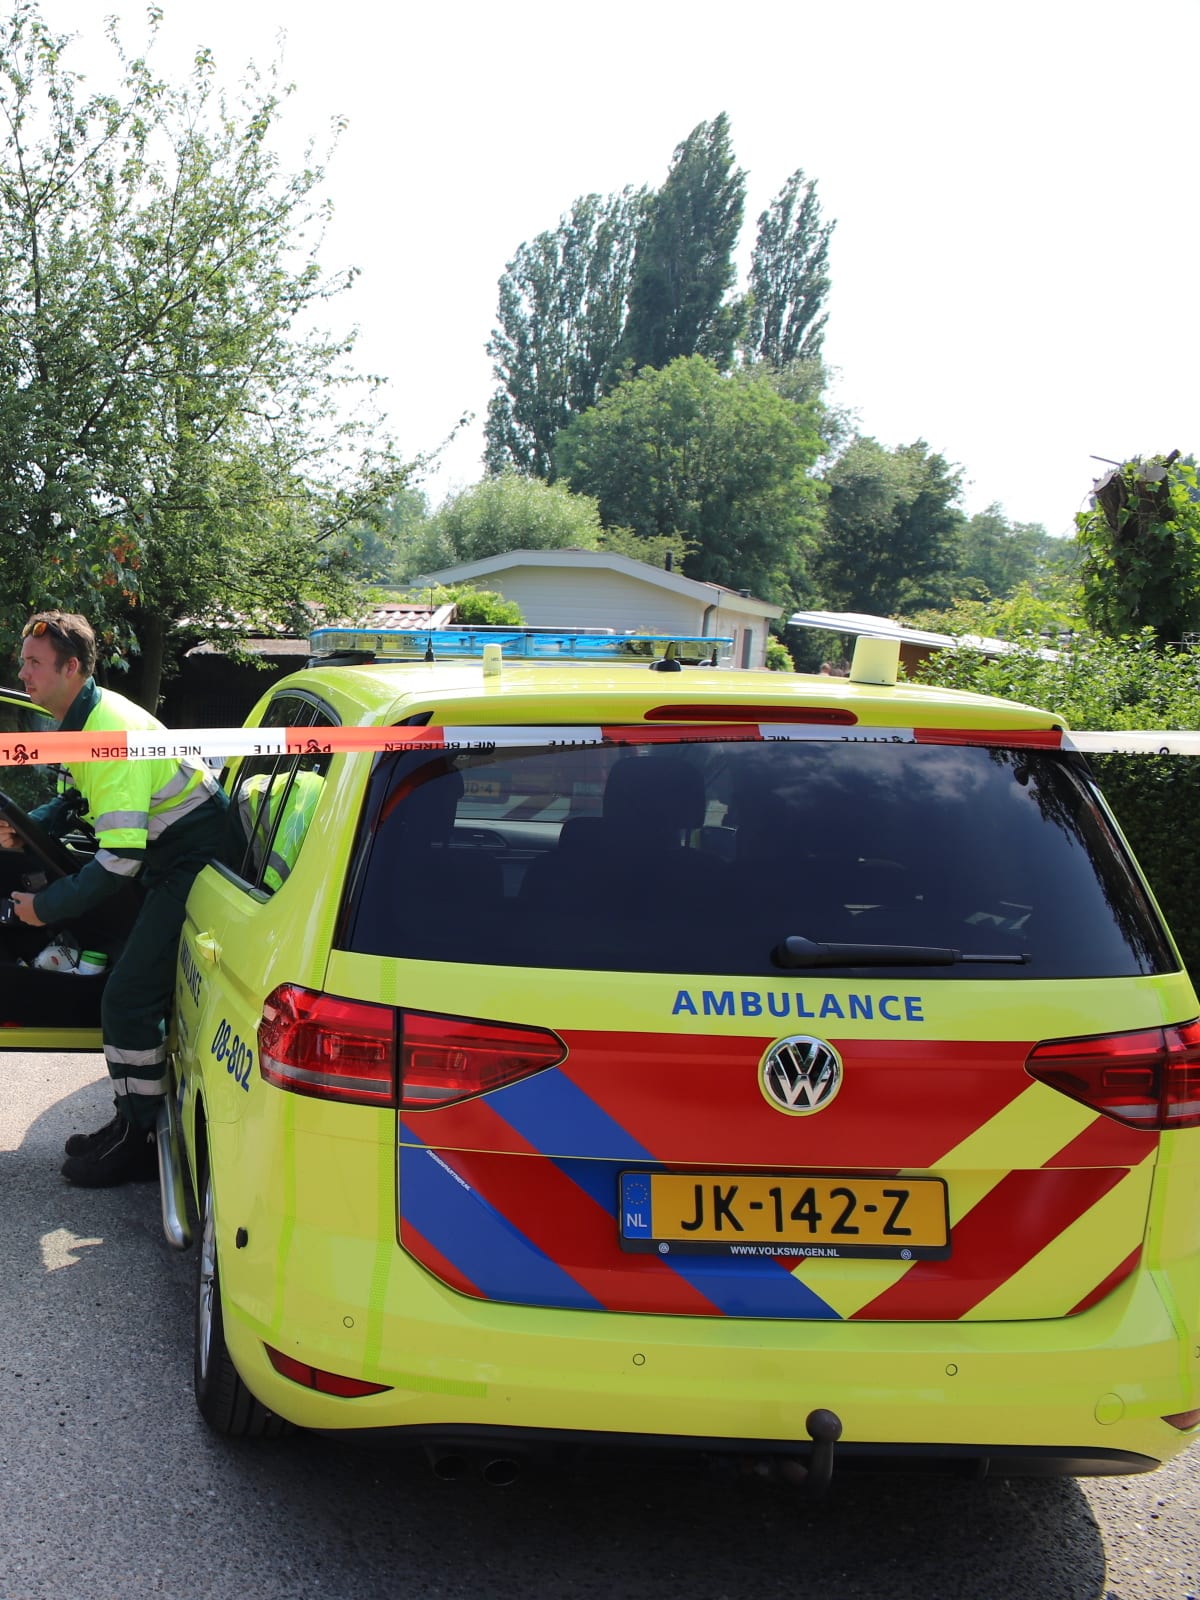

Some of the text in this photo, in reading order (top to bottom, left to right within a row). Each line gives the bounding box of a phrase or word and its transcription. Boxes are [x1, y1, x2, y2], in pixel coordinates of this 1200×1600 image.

[91, 746, 201, 757] NIET BETREDEN
[671, 989, 925, 1022] AMBULANCE
[211, 1018, 254, 1092] 08-802
[626, 1213, 648, 1228] NL
[680, 1183, 912, 1236] JK-142-Z
[730, 1245, 840, 1258] WWW.VOLKSWAGEN.NL
